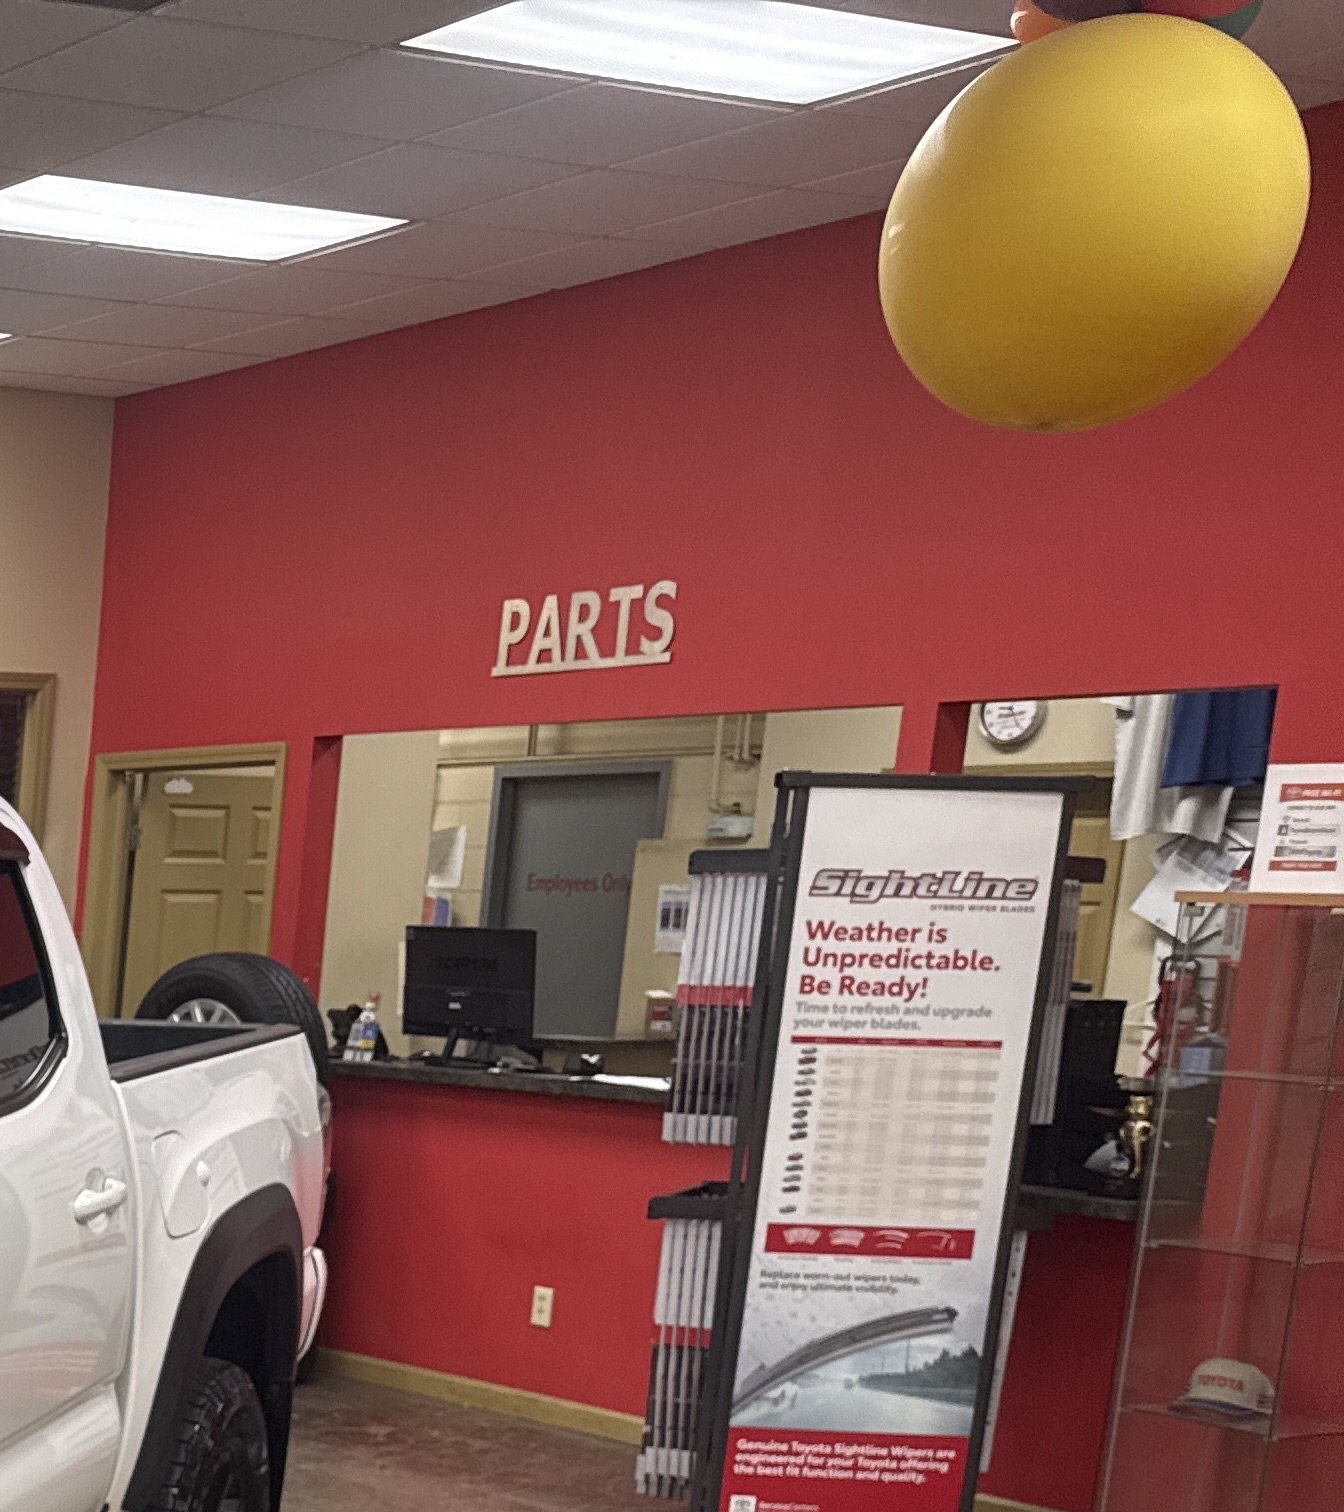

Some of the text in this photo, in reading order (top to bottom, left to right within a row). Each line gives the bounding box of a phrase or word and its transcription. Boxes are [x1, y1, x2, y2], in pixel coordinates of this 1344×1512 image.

[494, 580, 677, 668] PARTS
[527, 872, 598, 898] Employees
[808, 868, 1039, 904] SightLine
[967, 904, 997, 912] WIPER
[1000, 905, 1035, 913] BLADES
[805, 919, 948, 943] Weather is
[802, 946, 1001, 973] Unpredictable.
[799, 974, 929, 1002] Be Ready!
[795, 1001, 993, 1021] Time to refresh and upgrade
[793, 1017, 922, 1032] your wiper blades.
[736, 1438, 789, 1452] Genuine
[791, 1440, 832, 1455] Toyota
[891, 1445, 934, 1459] Wipers
[935, 1449, 956, 1460] are
[733, 1463, 754, 1475] the
[756, 1464, 784, 1477] best
[785, 1465, 801, 1478] fit
[802, 1466, 853, 1480] function
[855, 1469, 880, 1481] and
[734, 1452, 950, 1474] engineered for your Toyota offering
